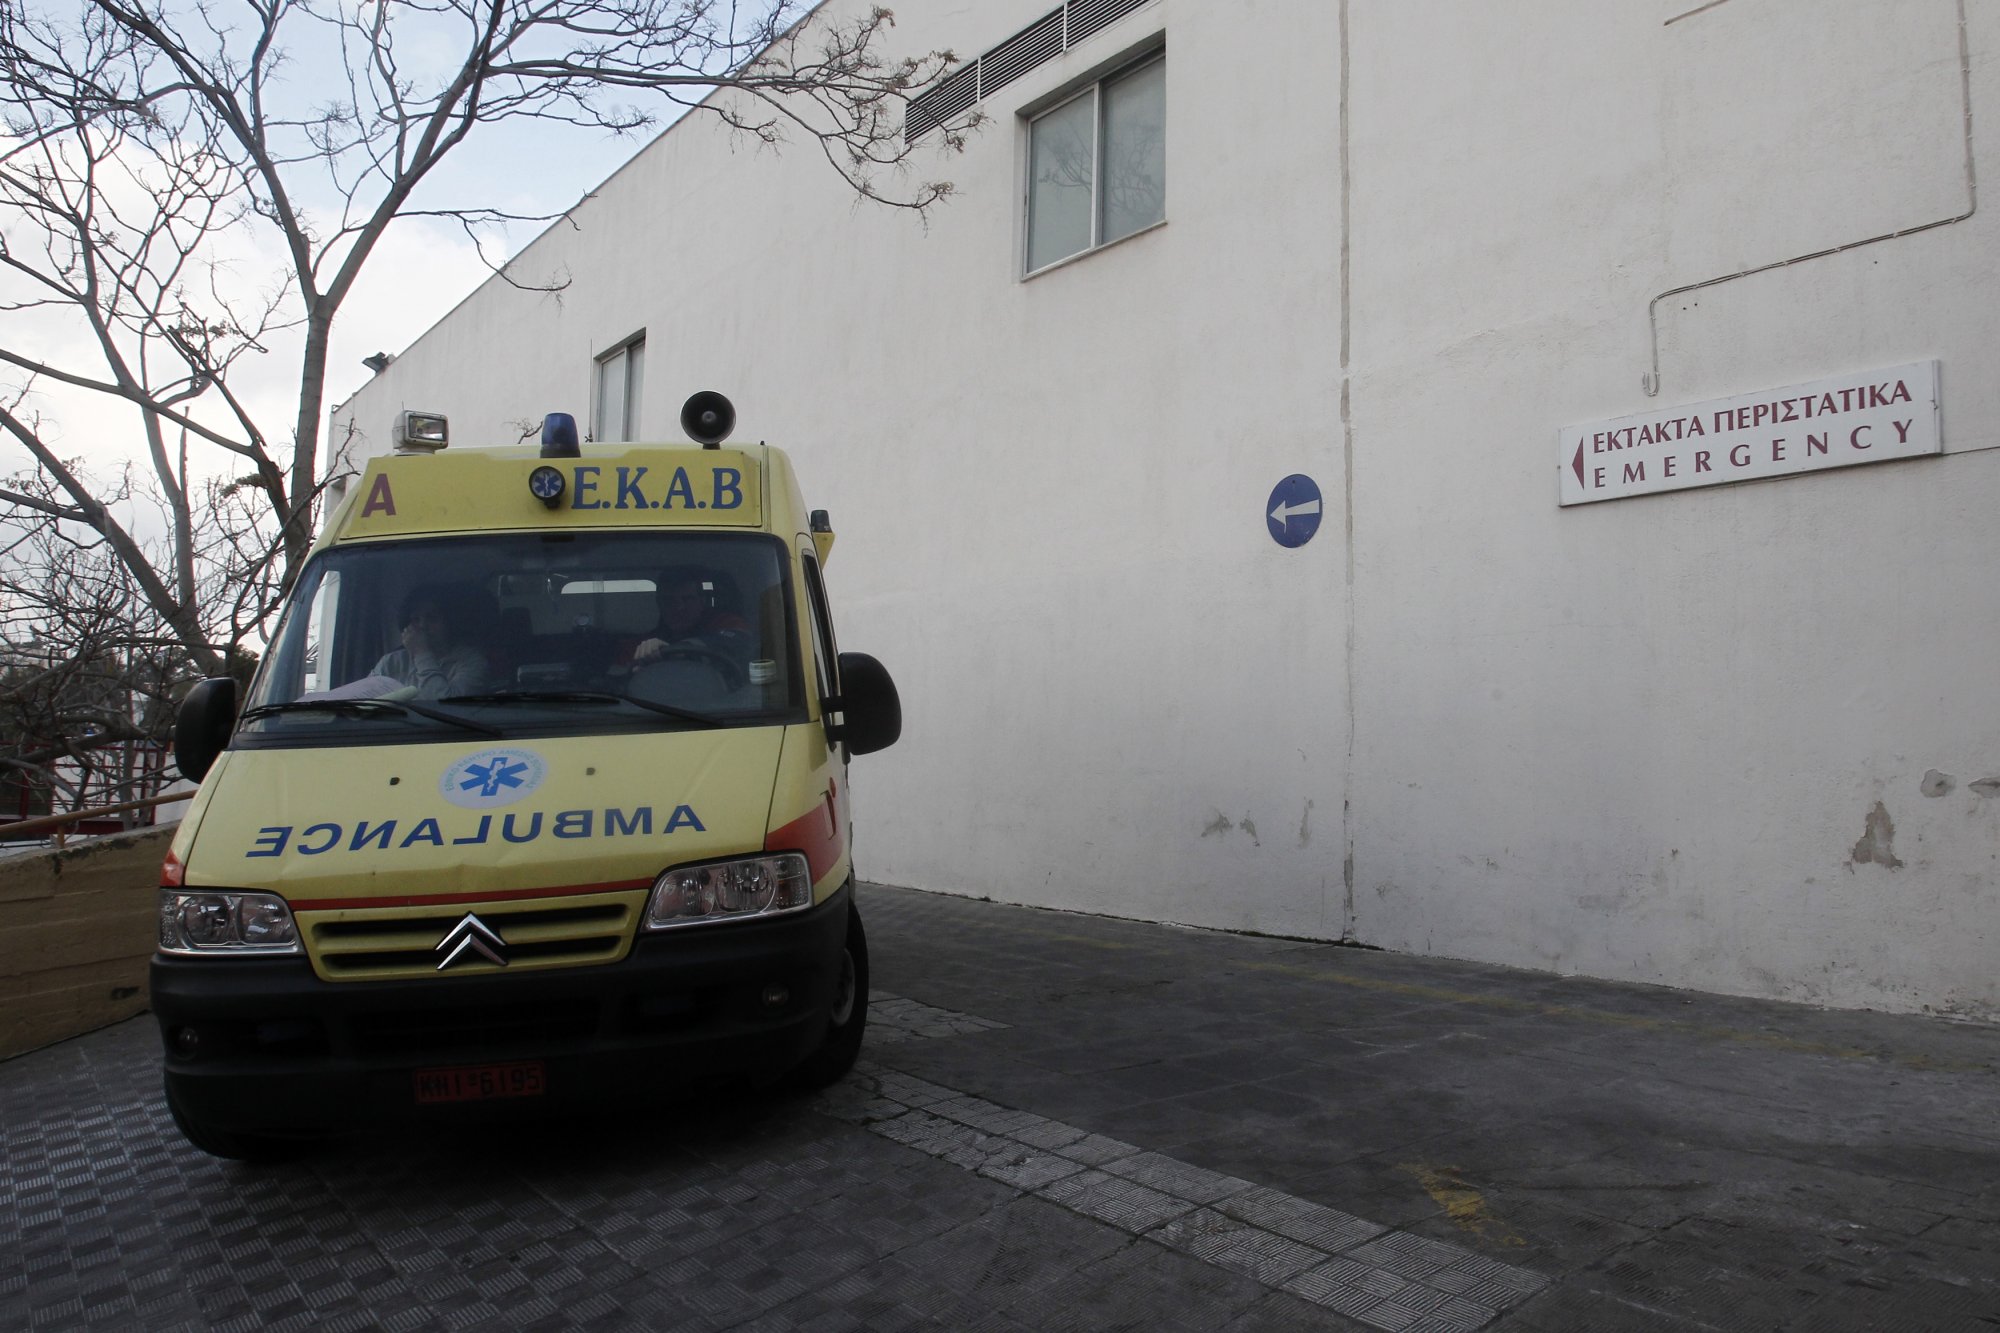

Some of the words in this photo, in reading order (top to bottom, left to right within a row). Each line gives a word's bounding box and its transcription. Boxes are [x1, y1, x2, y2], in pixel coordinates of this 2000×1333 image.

[1593, 415, 1705, 454] ΕΚΤΑΚΤΑ
[1714, 380, 1912, 433] ΠΕΡΙΣΤΑΤΙΚΑ
[1594, 418, 1913, 488] EMERGENCY
[361, 473, 396, 518] Α
